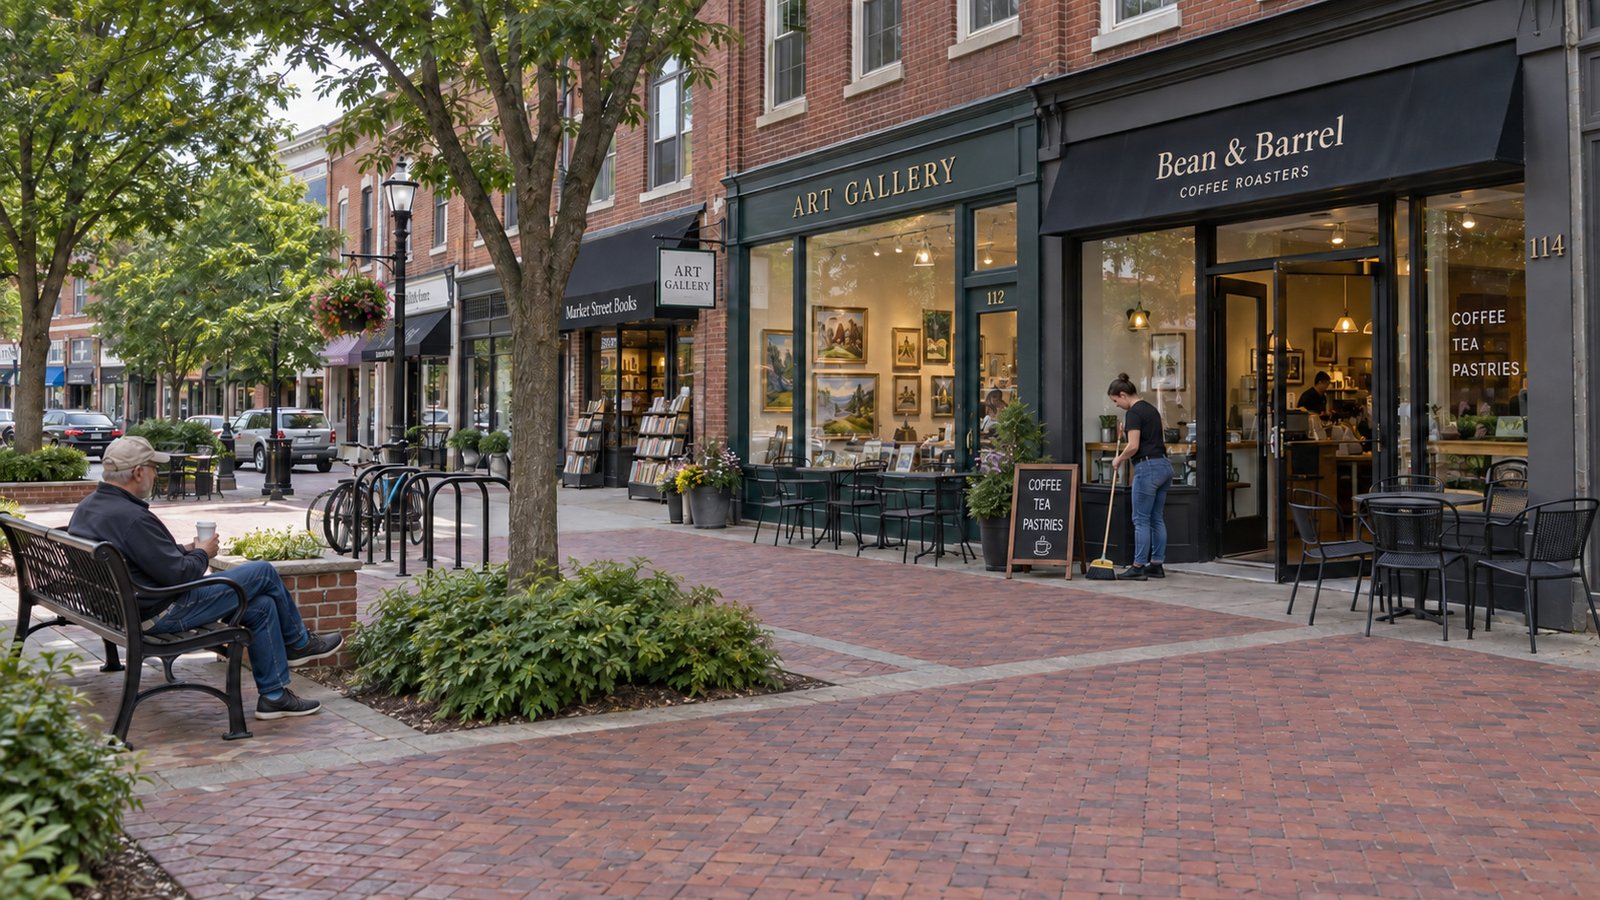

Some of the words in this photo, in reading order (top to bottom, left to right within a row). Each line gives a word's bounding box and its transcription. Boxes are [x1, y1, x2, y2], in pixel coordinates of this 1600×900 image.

[1156, 149, 1217, 181] Bean
[1224, 138, 1248, 167] &
[1253, 114, 1345, 163] Barrel
[792, 187, 833, 219] ART
[844, 156, 957, 206] GALLERY
[1179, 179, 1229, 199] COFFEE
[1235, 164, 1310, 190] ROASTERS
[1529, 233, 1565, 260] 114
[674, 265, 702, 278] ART
[664, 279, 711, 291] GALLERY
[986, 289, 1005, 306] 112
[565, 303, 590, 320] Market
[591, 301, 613, 317] Street
[614, 295, 638, 313] Books
[1451, 309, 1506, 326] COFFEE
[1452, 337, 1479, 352] TEA
[1451, 361, 1521, 378] PASTRIES
[1028, 478, 1062, 491] COFFEE
[1033, 498, 1051, 510] TEA
[1022, 518, 1063, 531] PASTRIES
